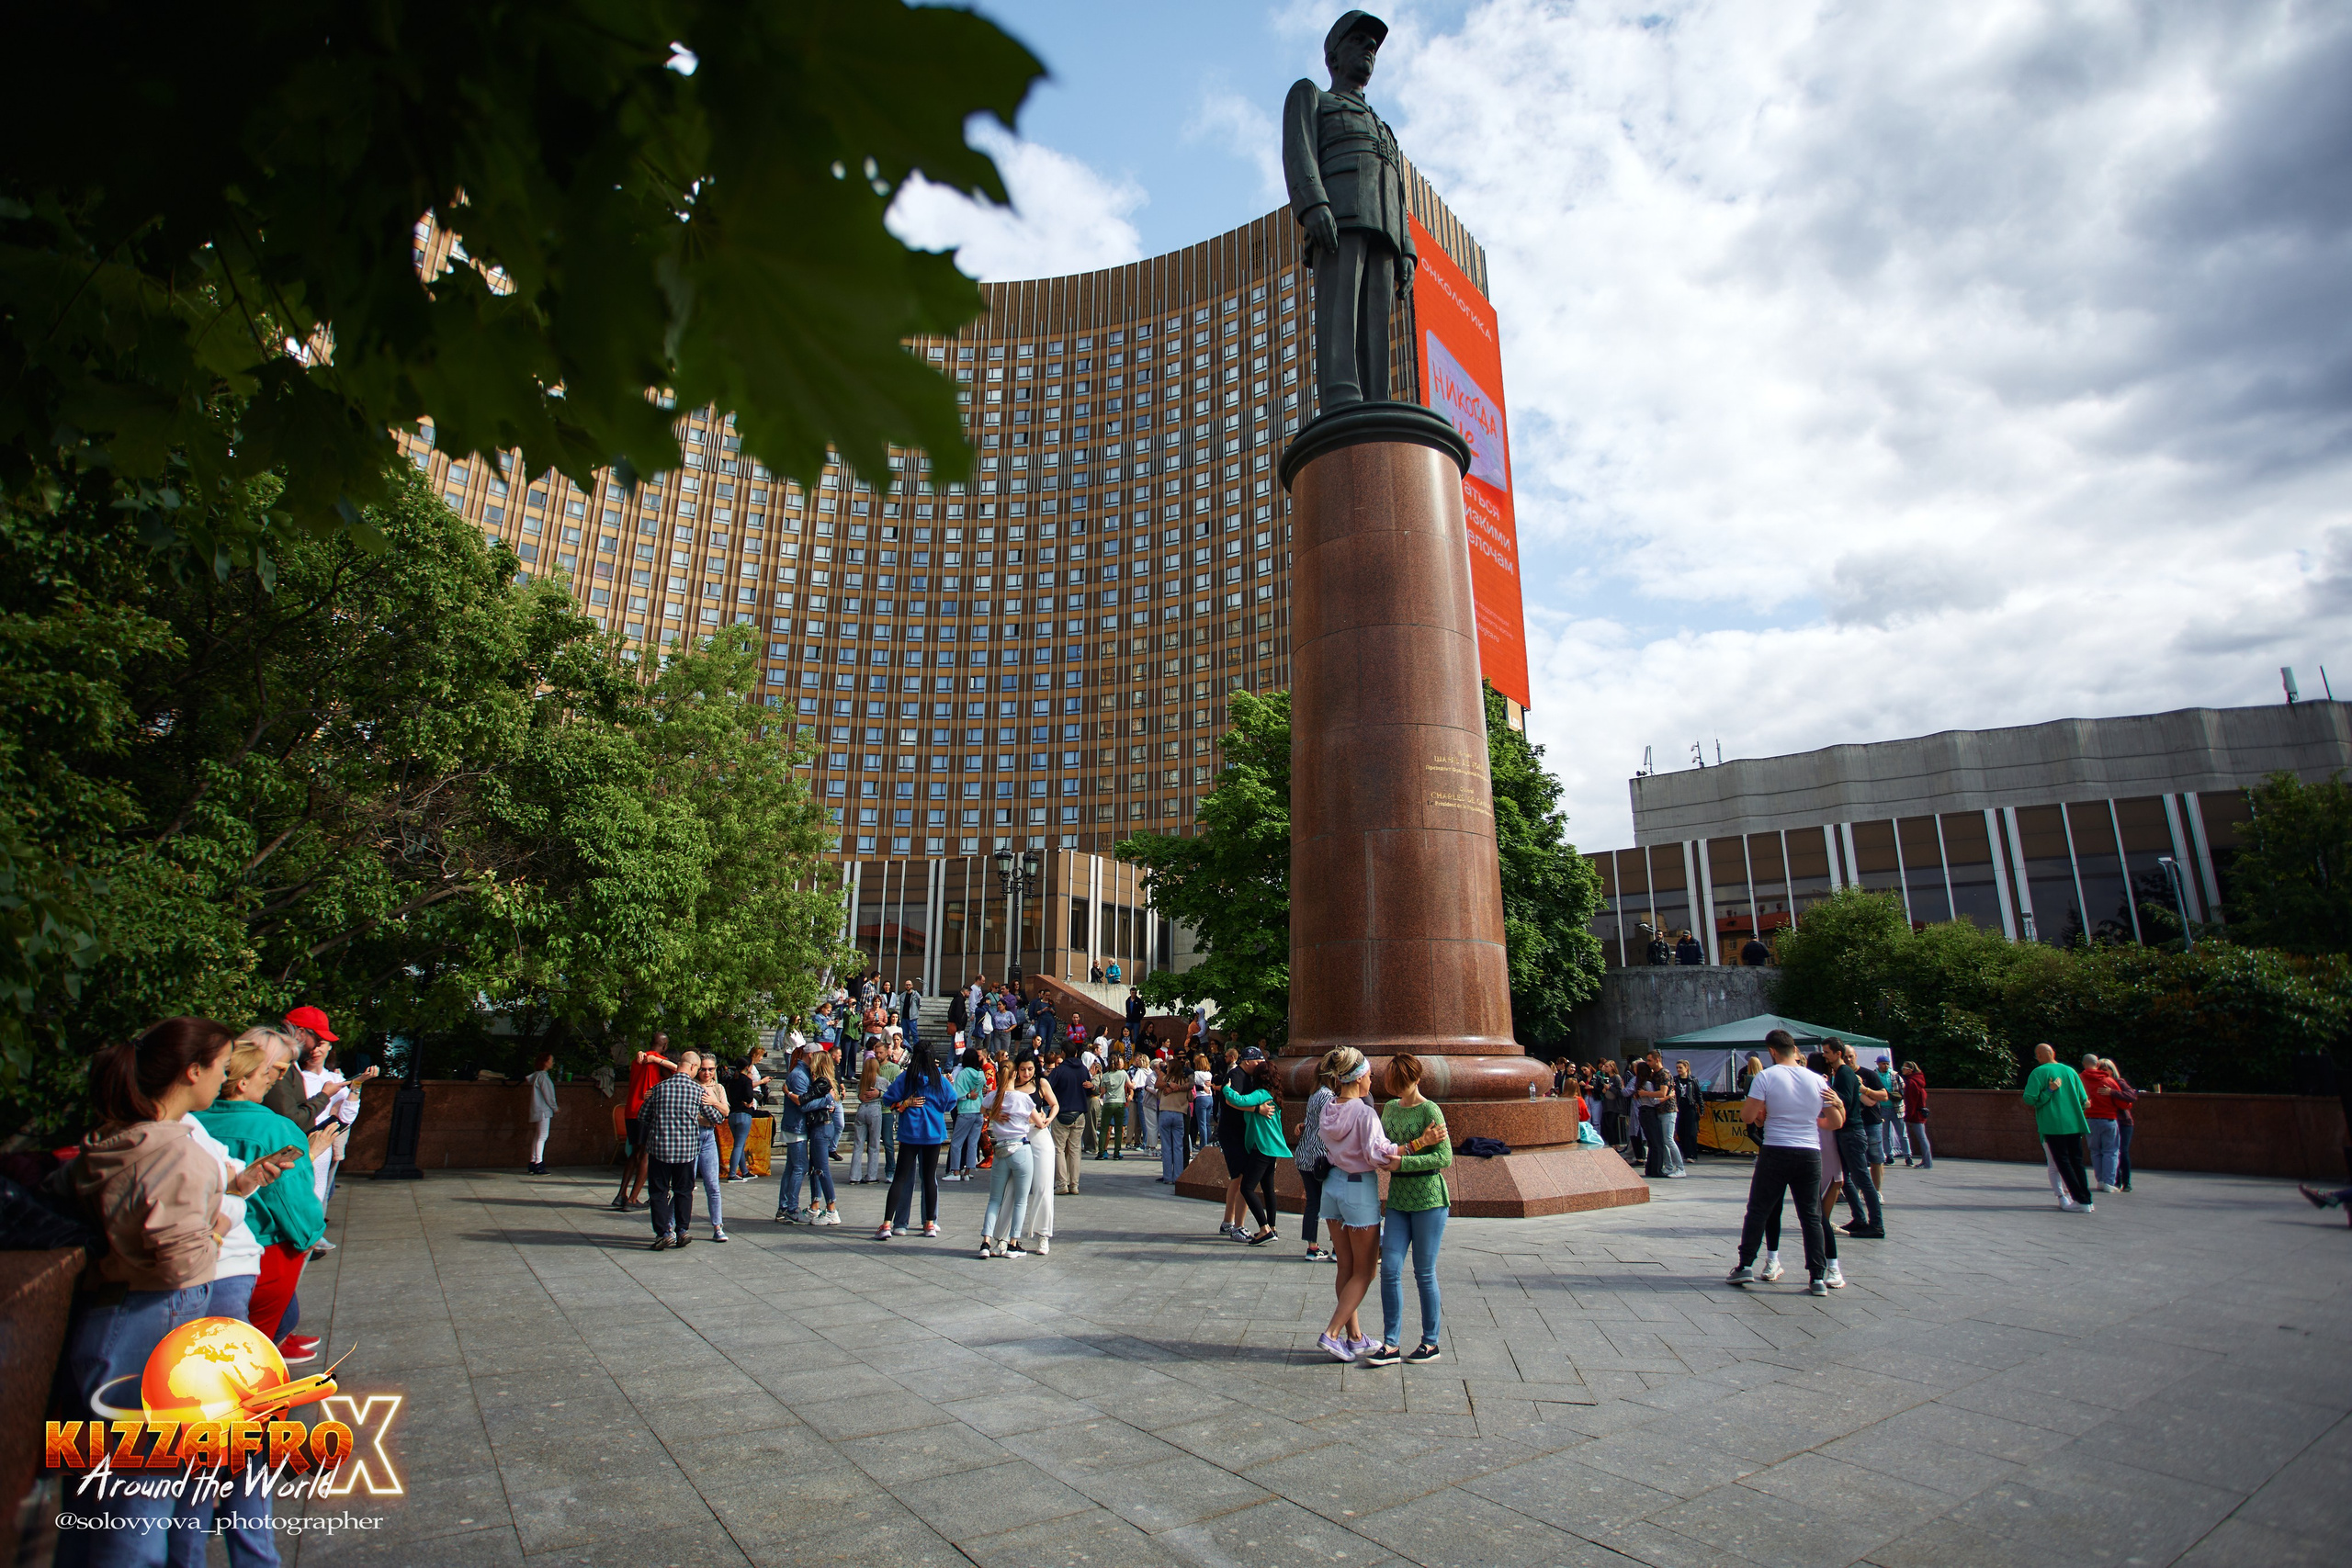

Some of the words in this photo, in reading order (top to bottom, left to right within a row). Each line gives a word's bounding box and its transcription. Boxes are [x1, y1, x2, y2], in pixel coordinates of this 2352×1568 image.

[1421, 257, 1492, 343] ОНКОЛОГИКА
[1432, 360, 1498, 439] НИКОГДА
[1464, 480, 1500, 521] аться
[1464, 502, 1511, 551] изкими
[1466, 528, 1514, 575] елочам
[1430, 791, 1465, 802] CHARLES
[1732, 1126, 1748, 1136] Mo
